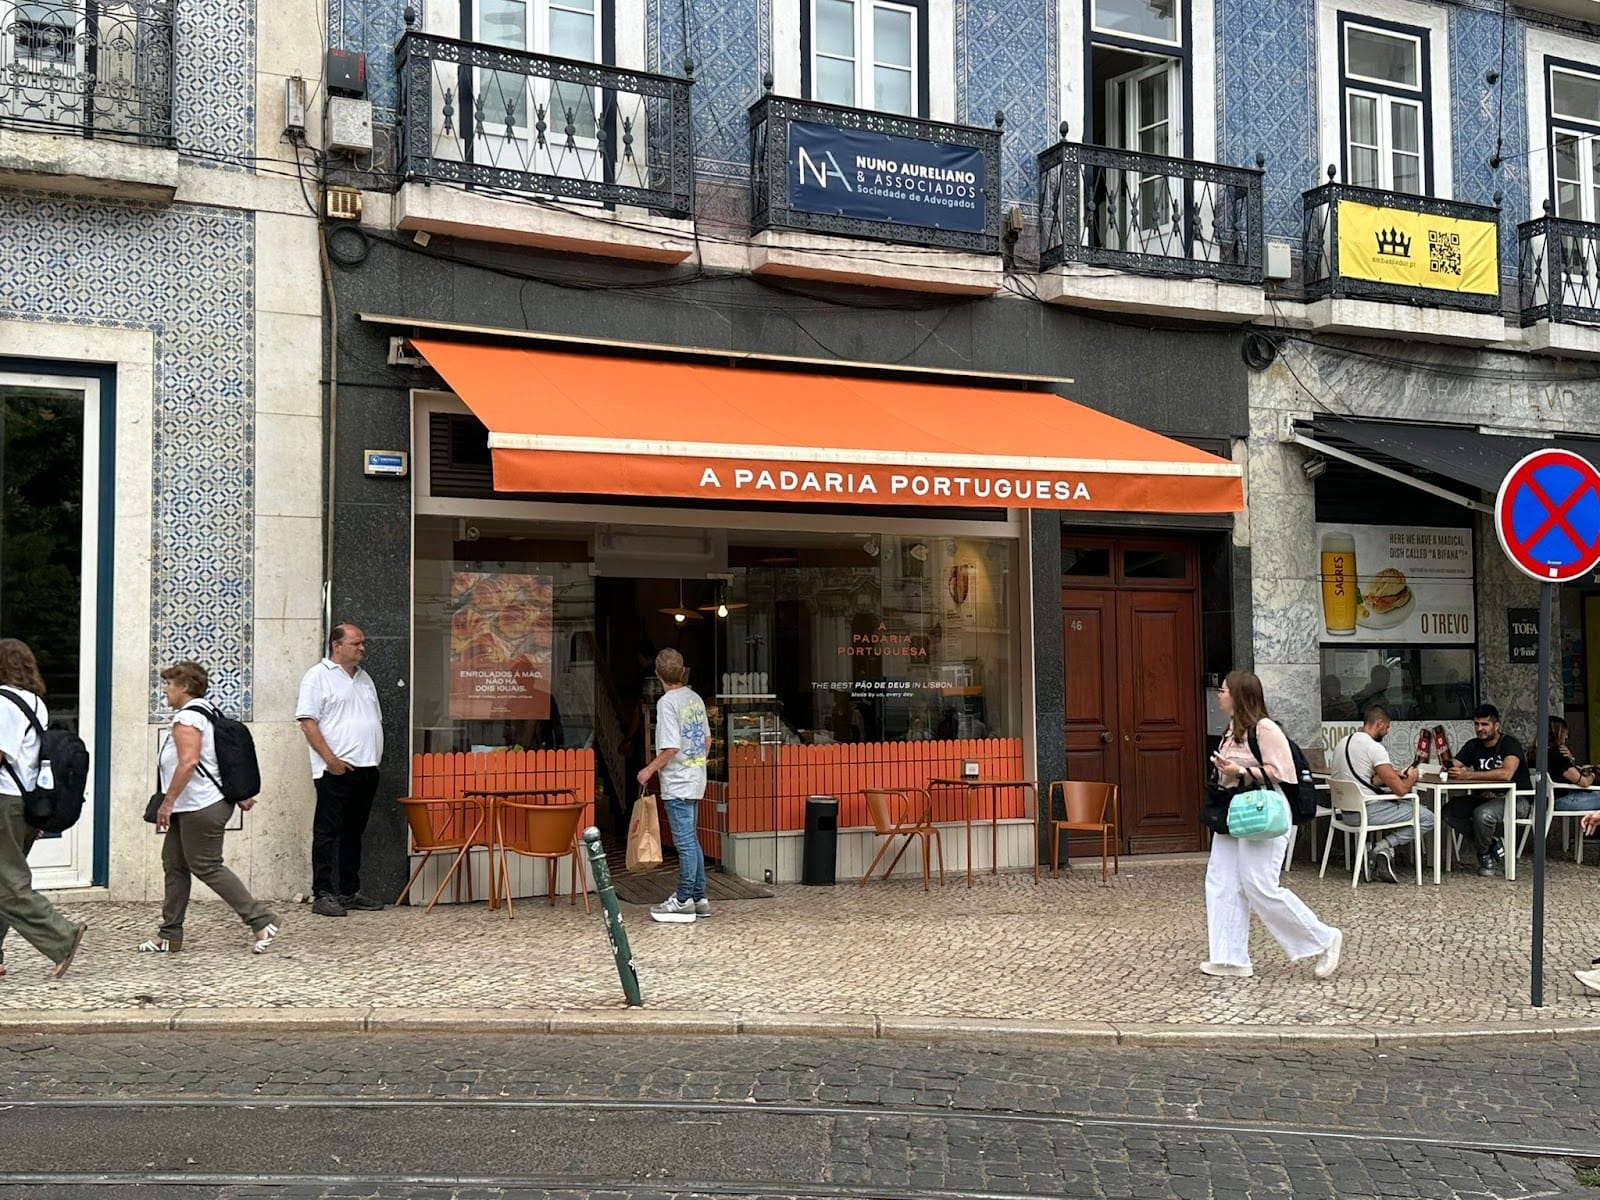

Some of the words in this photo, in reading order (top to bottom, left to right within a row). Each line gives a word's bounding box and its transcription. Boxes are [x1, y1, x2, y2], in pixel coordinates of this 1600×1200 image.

[856, 155, 897, 173] NUNO
[901, 162, 975, 184] AURELIANO
[856, 171, 865, 182] &
[875, 171, 976, 198] ASSOCIADOS
[857, 185, 906, 200] Sociedade
[909, 192, 921, 202] de
[923, 195, 975, 209] Advogados
[700, 468, 721, 488] A
[735, 469, 878, 494] PADARIA
[891, 475, 1091, 500] PORTUGUESA
[1389, 533, 1404, 544] HERE
[1406, 534, 1415, 544] WE
[1417, 534, 1431, 545] HAVE
[1432, 535, 1437, 545] A
[1438, 536, 1465, 546] MAGICAL
[1389, 548, 1404, 558] DISH
[1406, 548, 1428, 559] CALLED
[1333, 556, 1345, 596] SAGRES
[878, 622, 887, 631] A
[1071, 620, 1082, 631] 46
[1421, 613, 1429, 634] O
[1432, 613, 1469, 635] TREVO
[1512, 623, 1538, 634] TOFA
[853, 634, 912, 644] PADARIA
[838, 647, 927, 656] PORTUGUESA
[1513, 647, 1519, 656] O
[854, 680, 872, 689] PÃO
